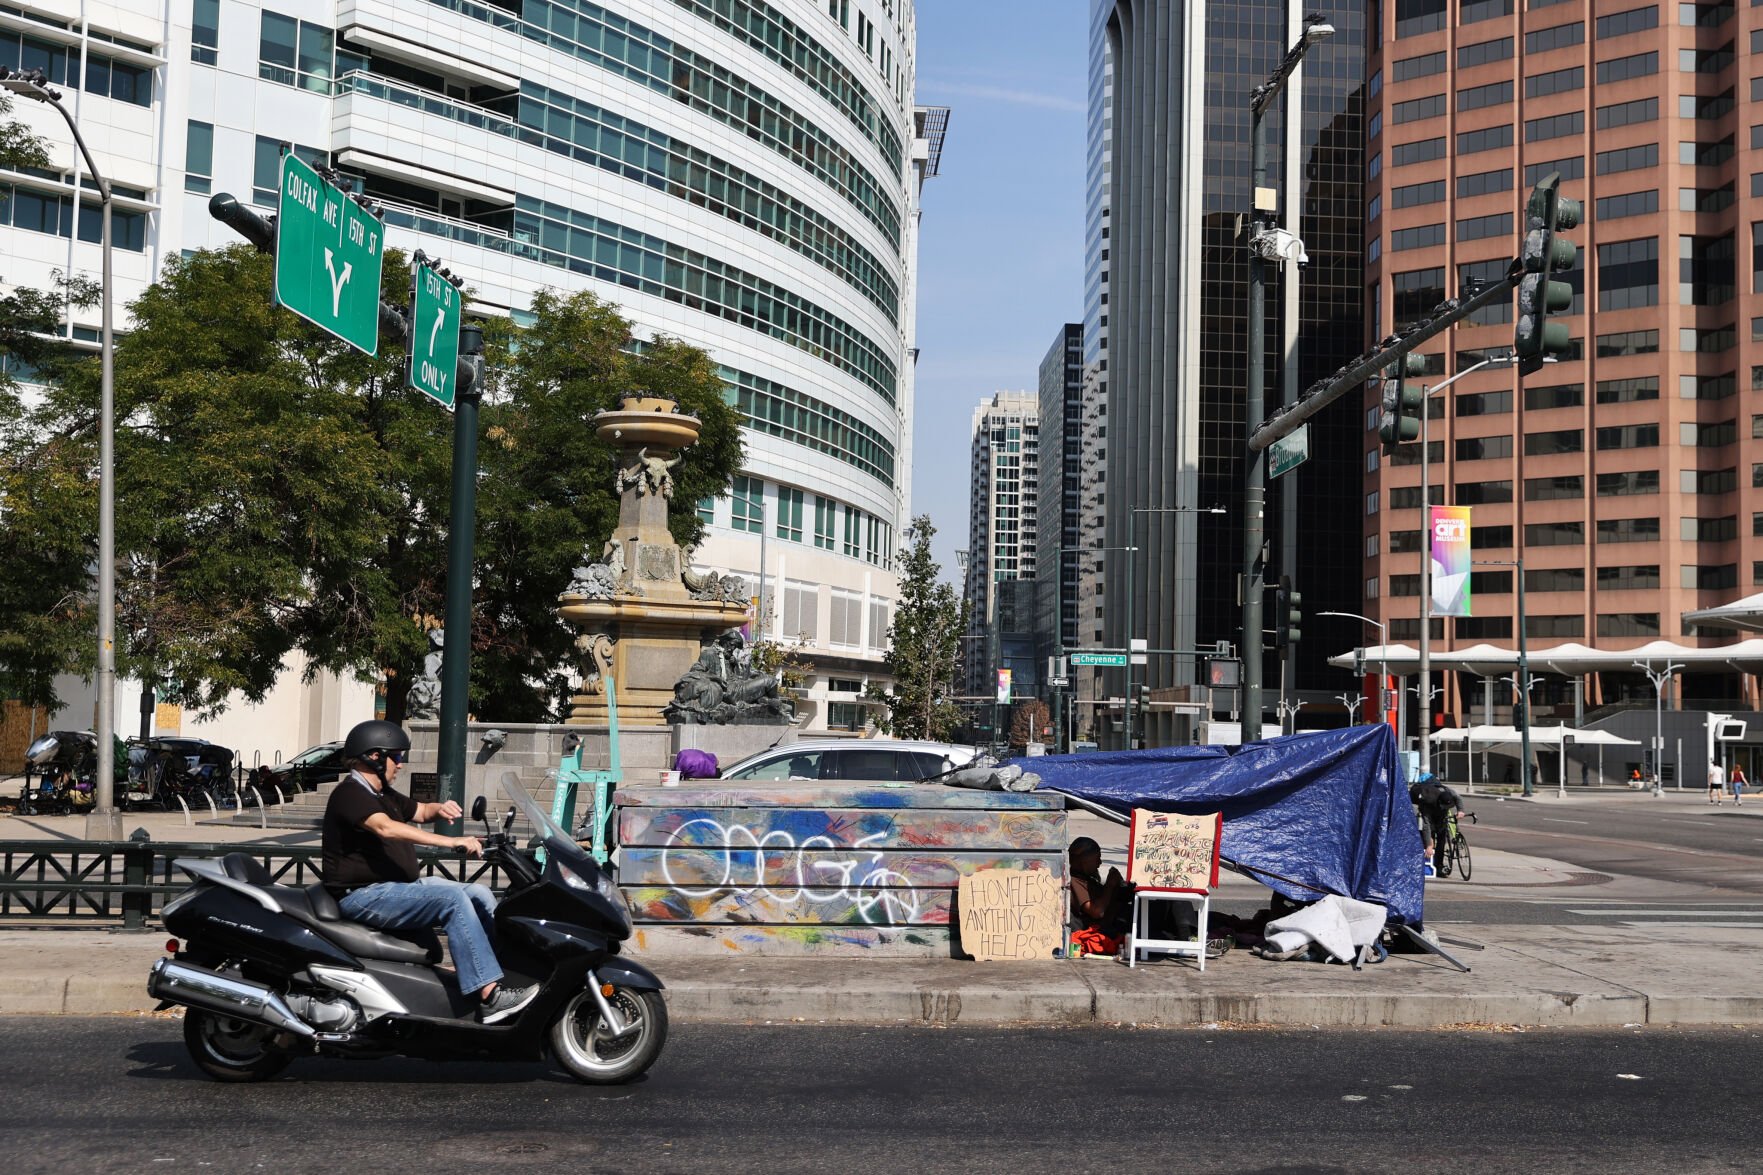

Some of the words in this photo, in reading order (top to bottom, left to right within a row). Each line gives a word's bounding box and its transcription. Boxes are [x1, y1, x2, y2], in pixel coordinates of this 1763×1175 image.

[287, 171, 317, 214] COLFAX
[323, 203, 336, 229] AVE
[349, 216, 365, 248] 15TH
[368, 233, 378, 256] ST
[426, 273, 441, 300] 15TH
[444, 287, 453, 308] ST
[421, 360, 447, 393] ONLY
[1435, 519, 1466, 536] art
[1080, 655, 1117, 664] Cheyenne
[970, 873, 1056, 908] HOMELESS
[964, 906, 1036, 933] ANYTHING
[980, 933, 1038, 960] HELPS
